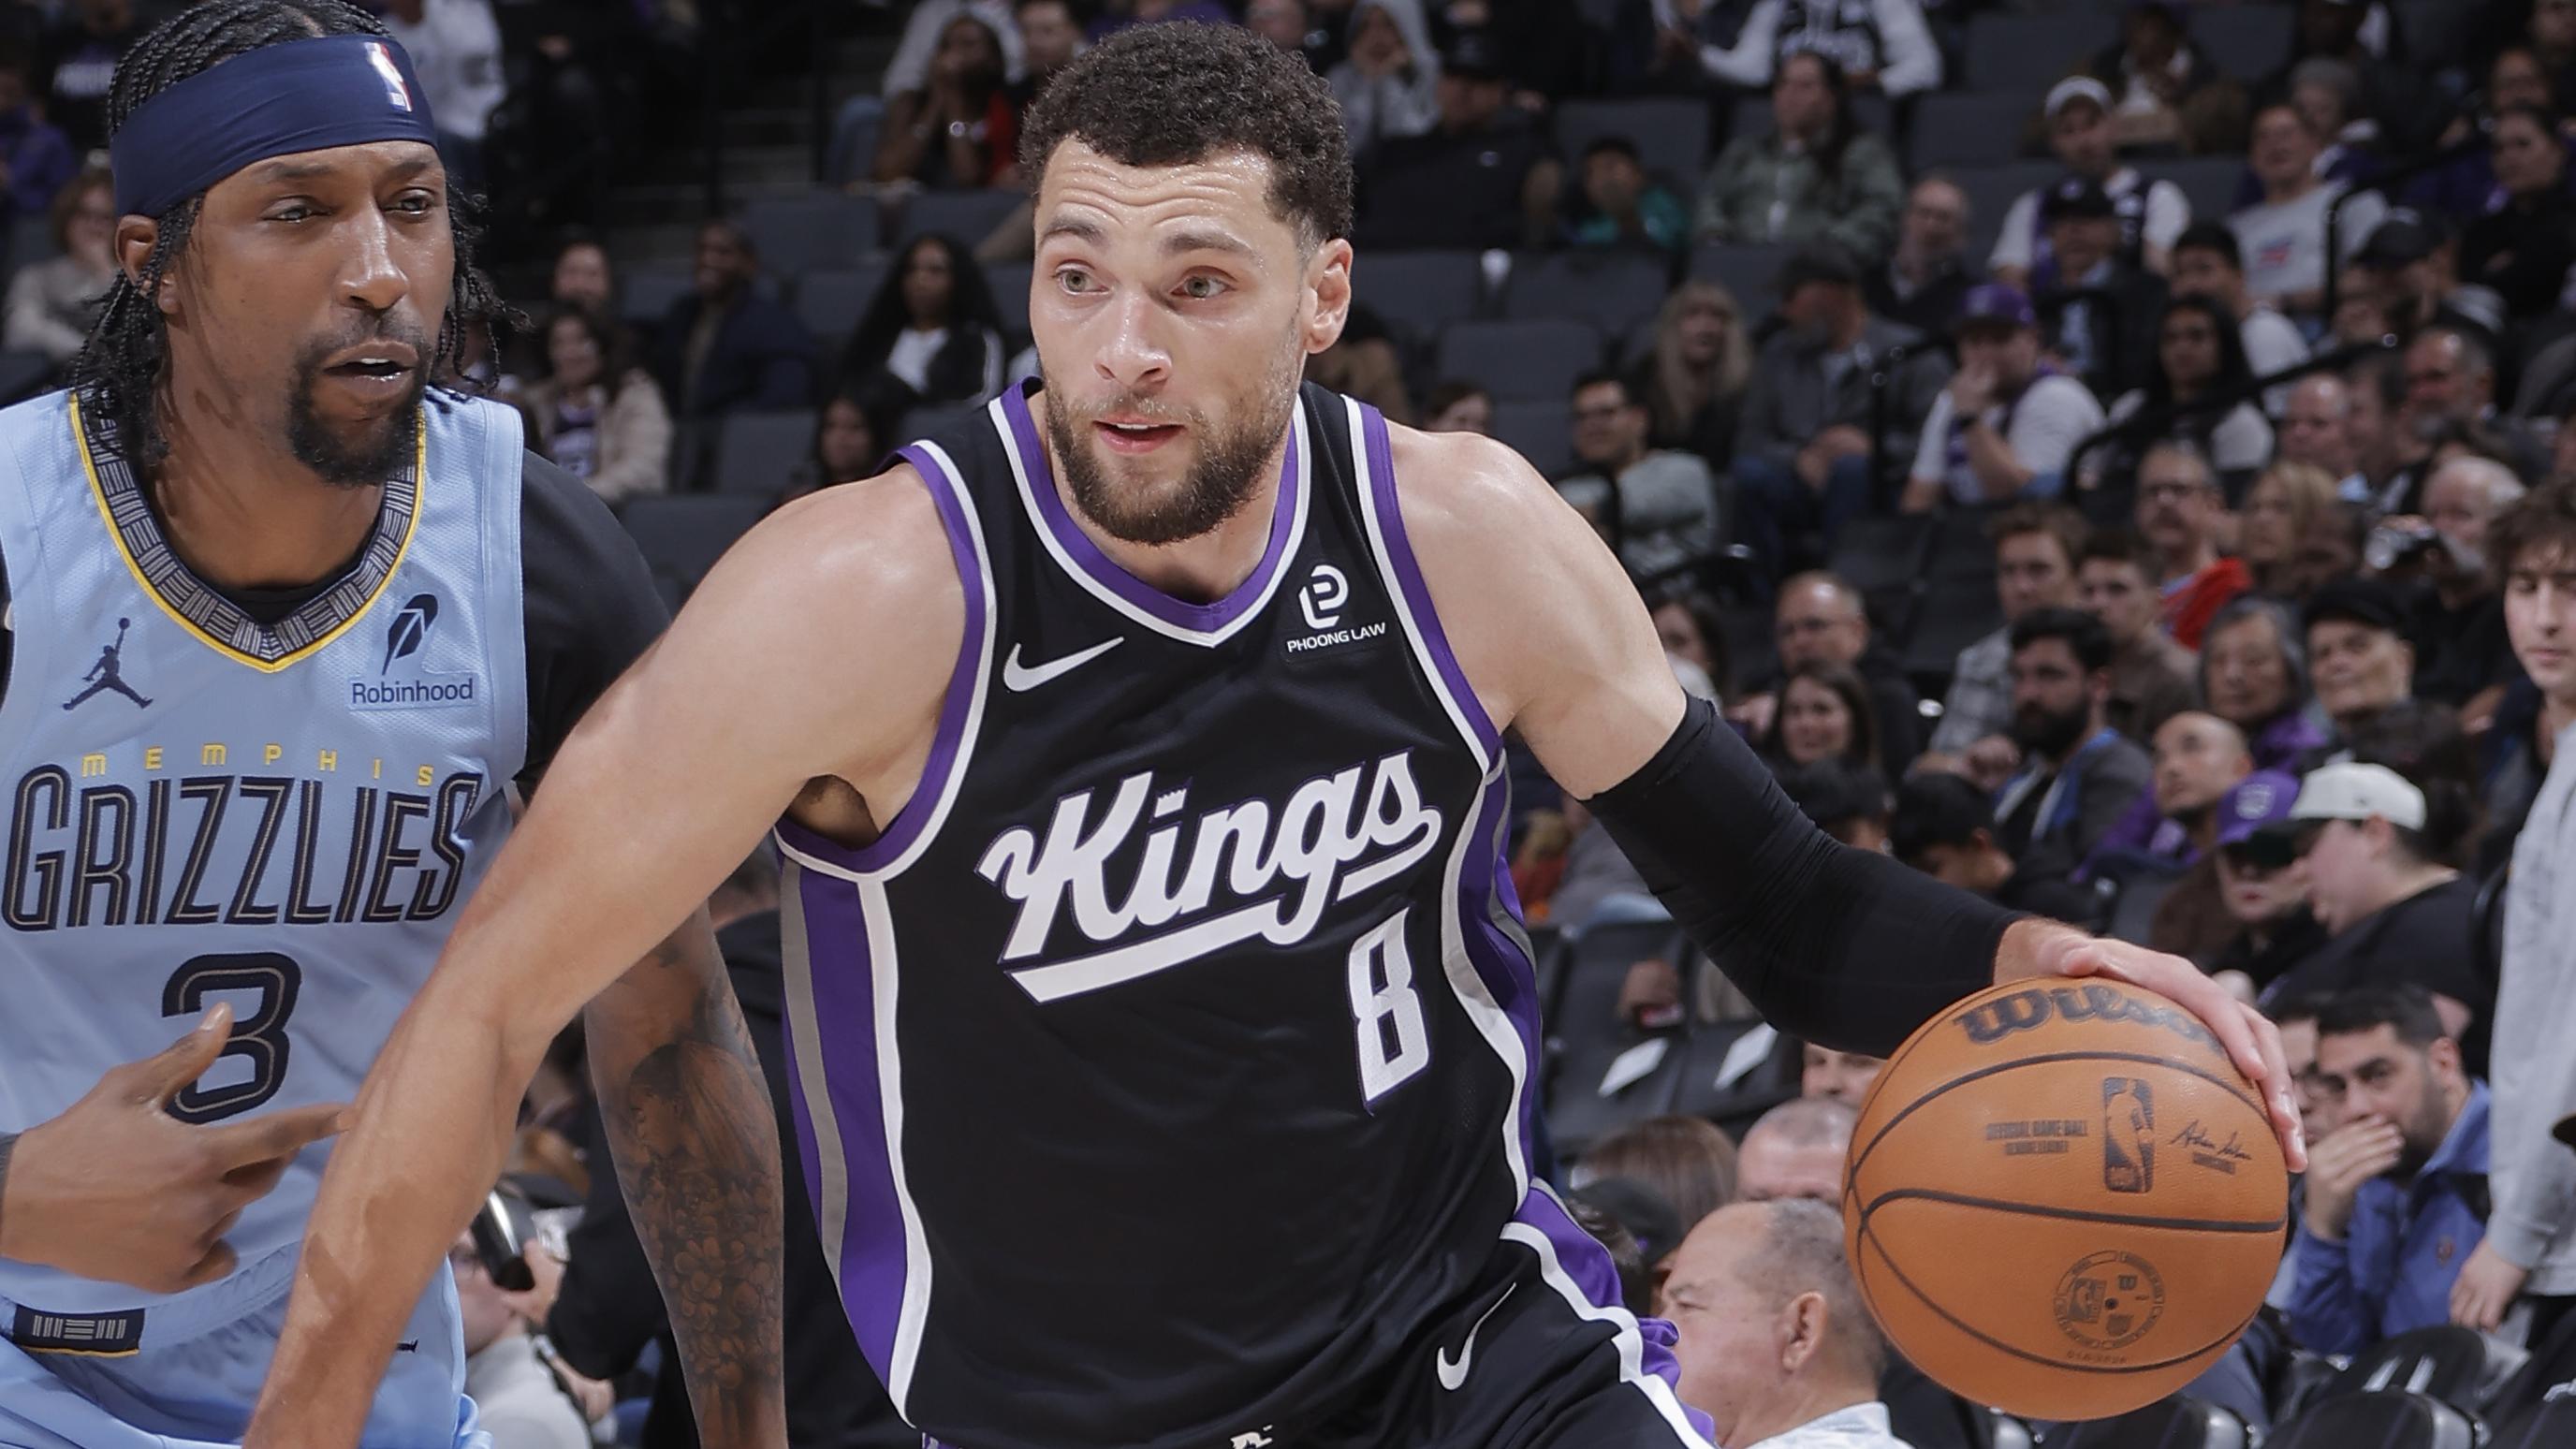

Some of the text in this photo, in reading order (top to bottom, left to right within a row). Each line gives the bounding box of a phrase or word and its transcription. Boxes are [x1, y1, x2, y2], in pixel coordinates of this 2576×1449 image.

[352, 678, 473, 704] Robinhood
[1287, 622, 1385, 652] PHOONG LAW
[1, 764, 483, 932] GRIZZLIES
[81, 743, 434, 786] MEMPHIS
[975, 751, 1442, 1003] Kings
[162, 952, 302, 1125] 3
[1347, 906, 1430, 1103] 8
